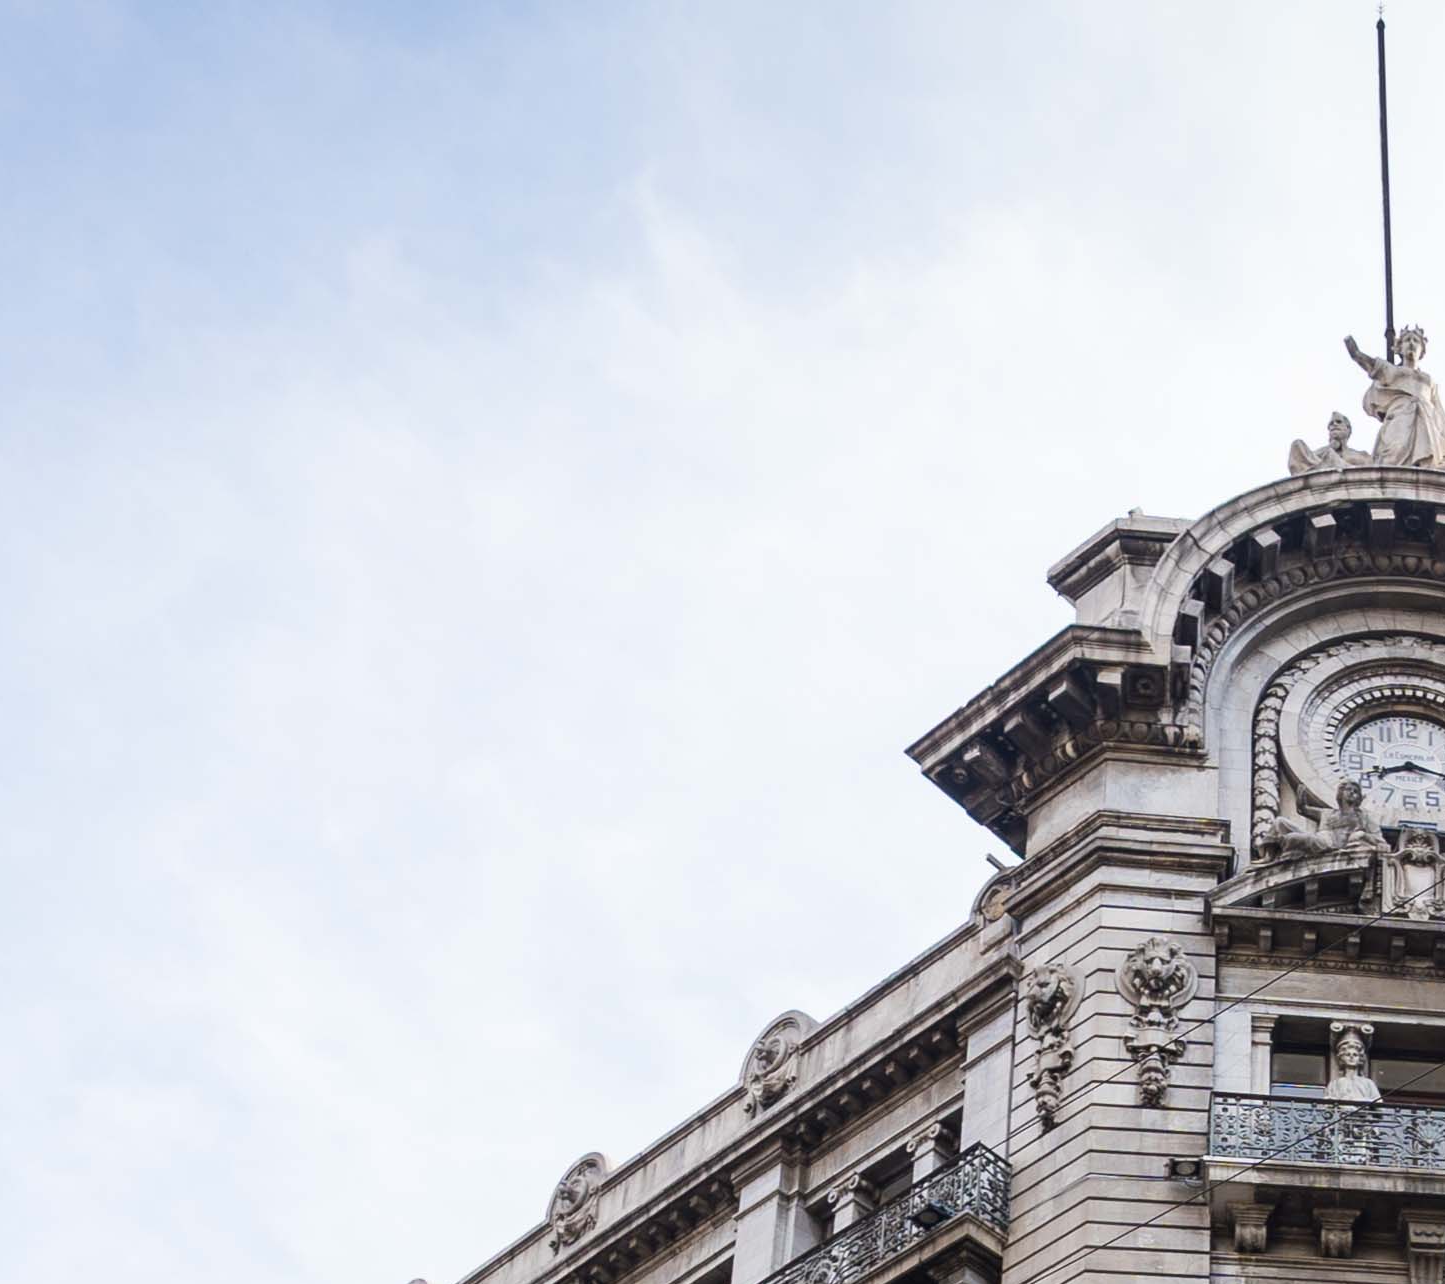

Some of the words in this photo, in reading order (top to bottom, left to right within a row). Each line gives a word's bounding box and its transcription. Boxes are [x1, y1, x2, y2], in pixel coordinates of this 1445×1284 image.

[1379, 726, 1392, 743] 11
[1399, 722, 1418, 740] 12
[1356, 736, 1374, 753] 10
[1349, 754, 1363, 770] 9
[1380, 787, 1395, 803] 7
[1426, 791, 1440, 807] 5
